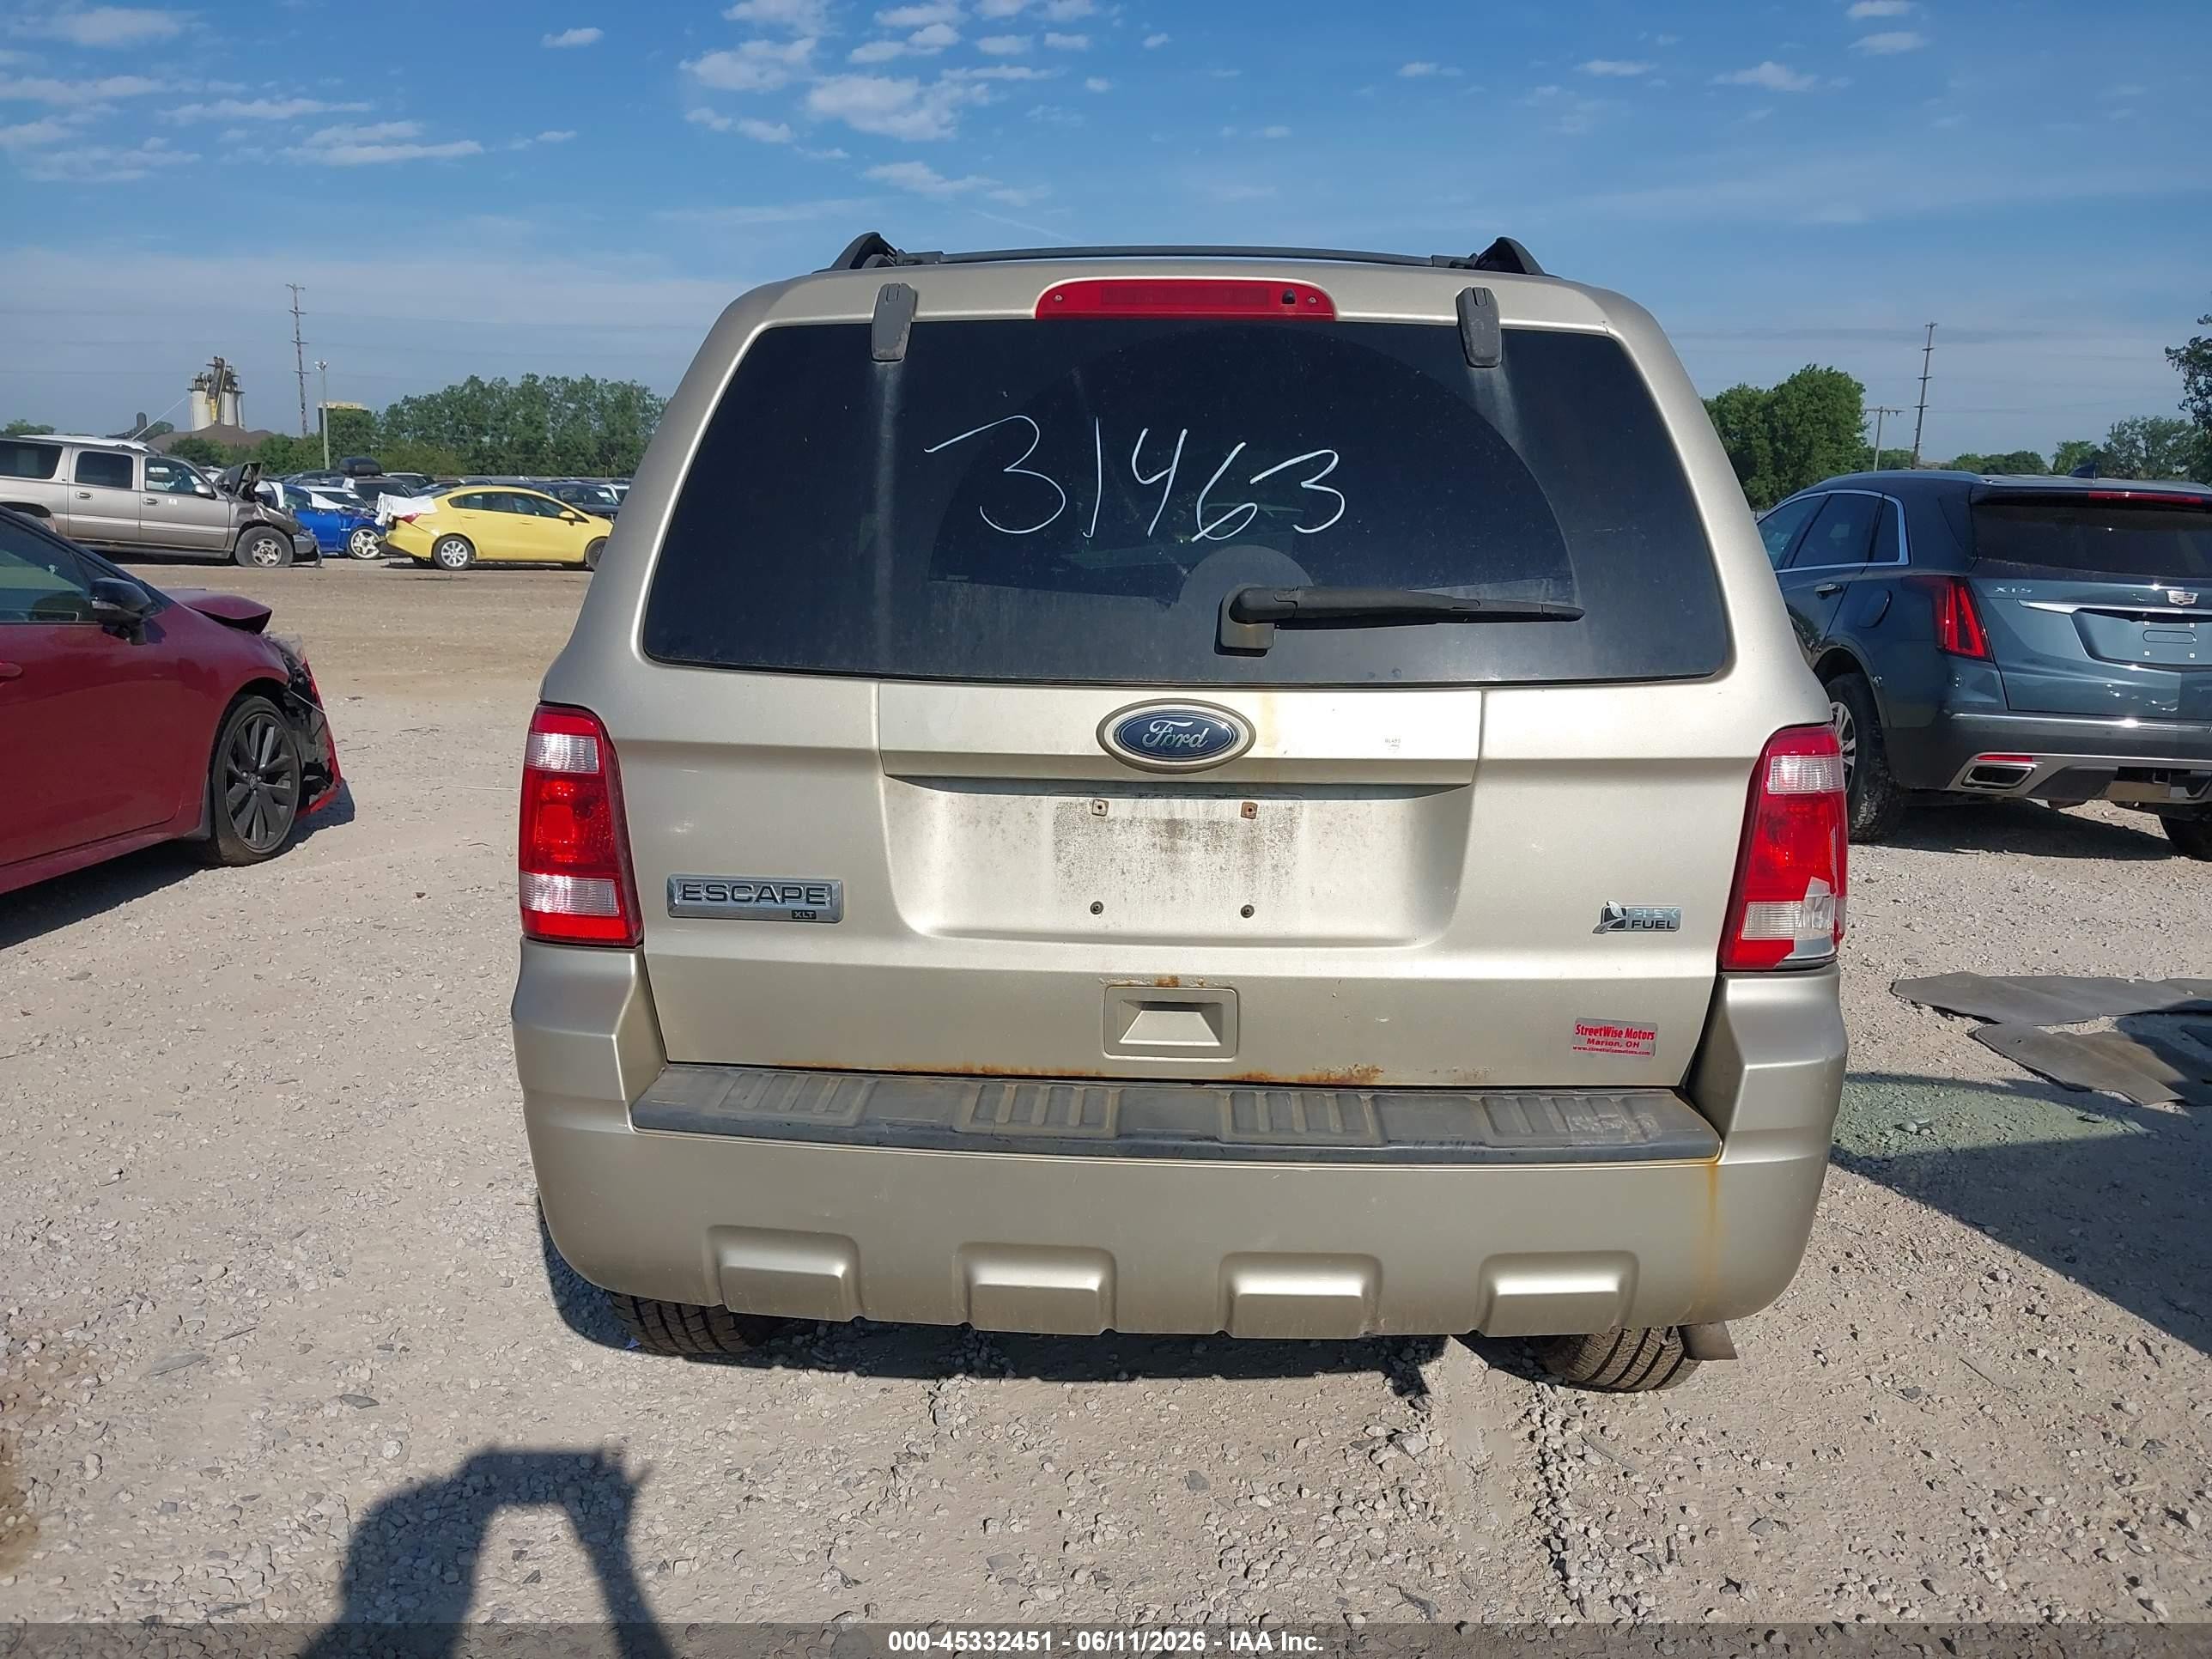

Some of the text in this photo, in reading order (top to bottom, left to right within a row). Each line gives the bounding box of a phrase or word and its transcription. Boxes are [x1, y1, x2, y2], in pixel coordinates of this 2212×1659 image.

[924, 415, 1346, 542] 31463
[1142, 720, 1209, 748] Ford
[682, 884, 828, 905] ESCAPE
[1633, 908, 1678, 919] FLEX
[1631, 920, 1676, 929] FUEL
[1575, 1024, 1656, 1041] StreetWise Motors
[1586, 1038, 1623, 1048] Marion,
